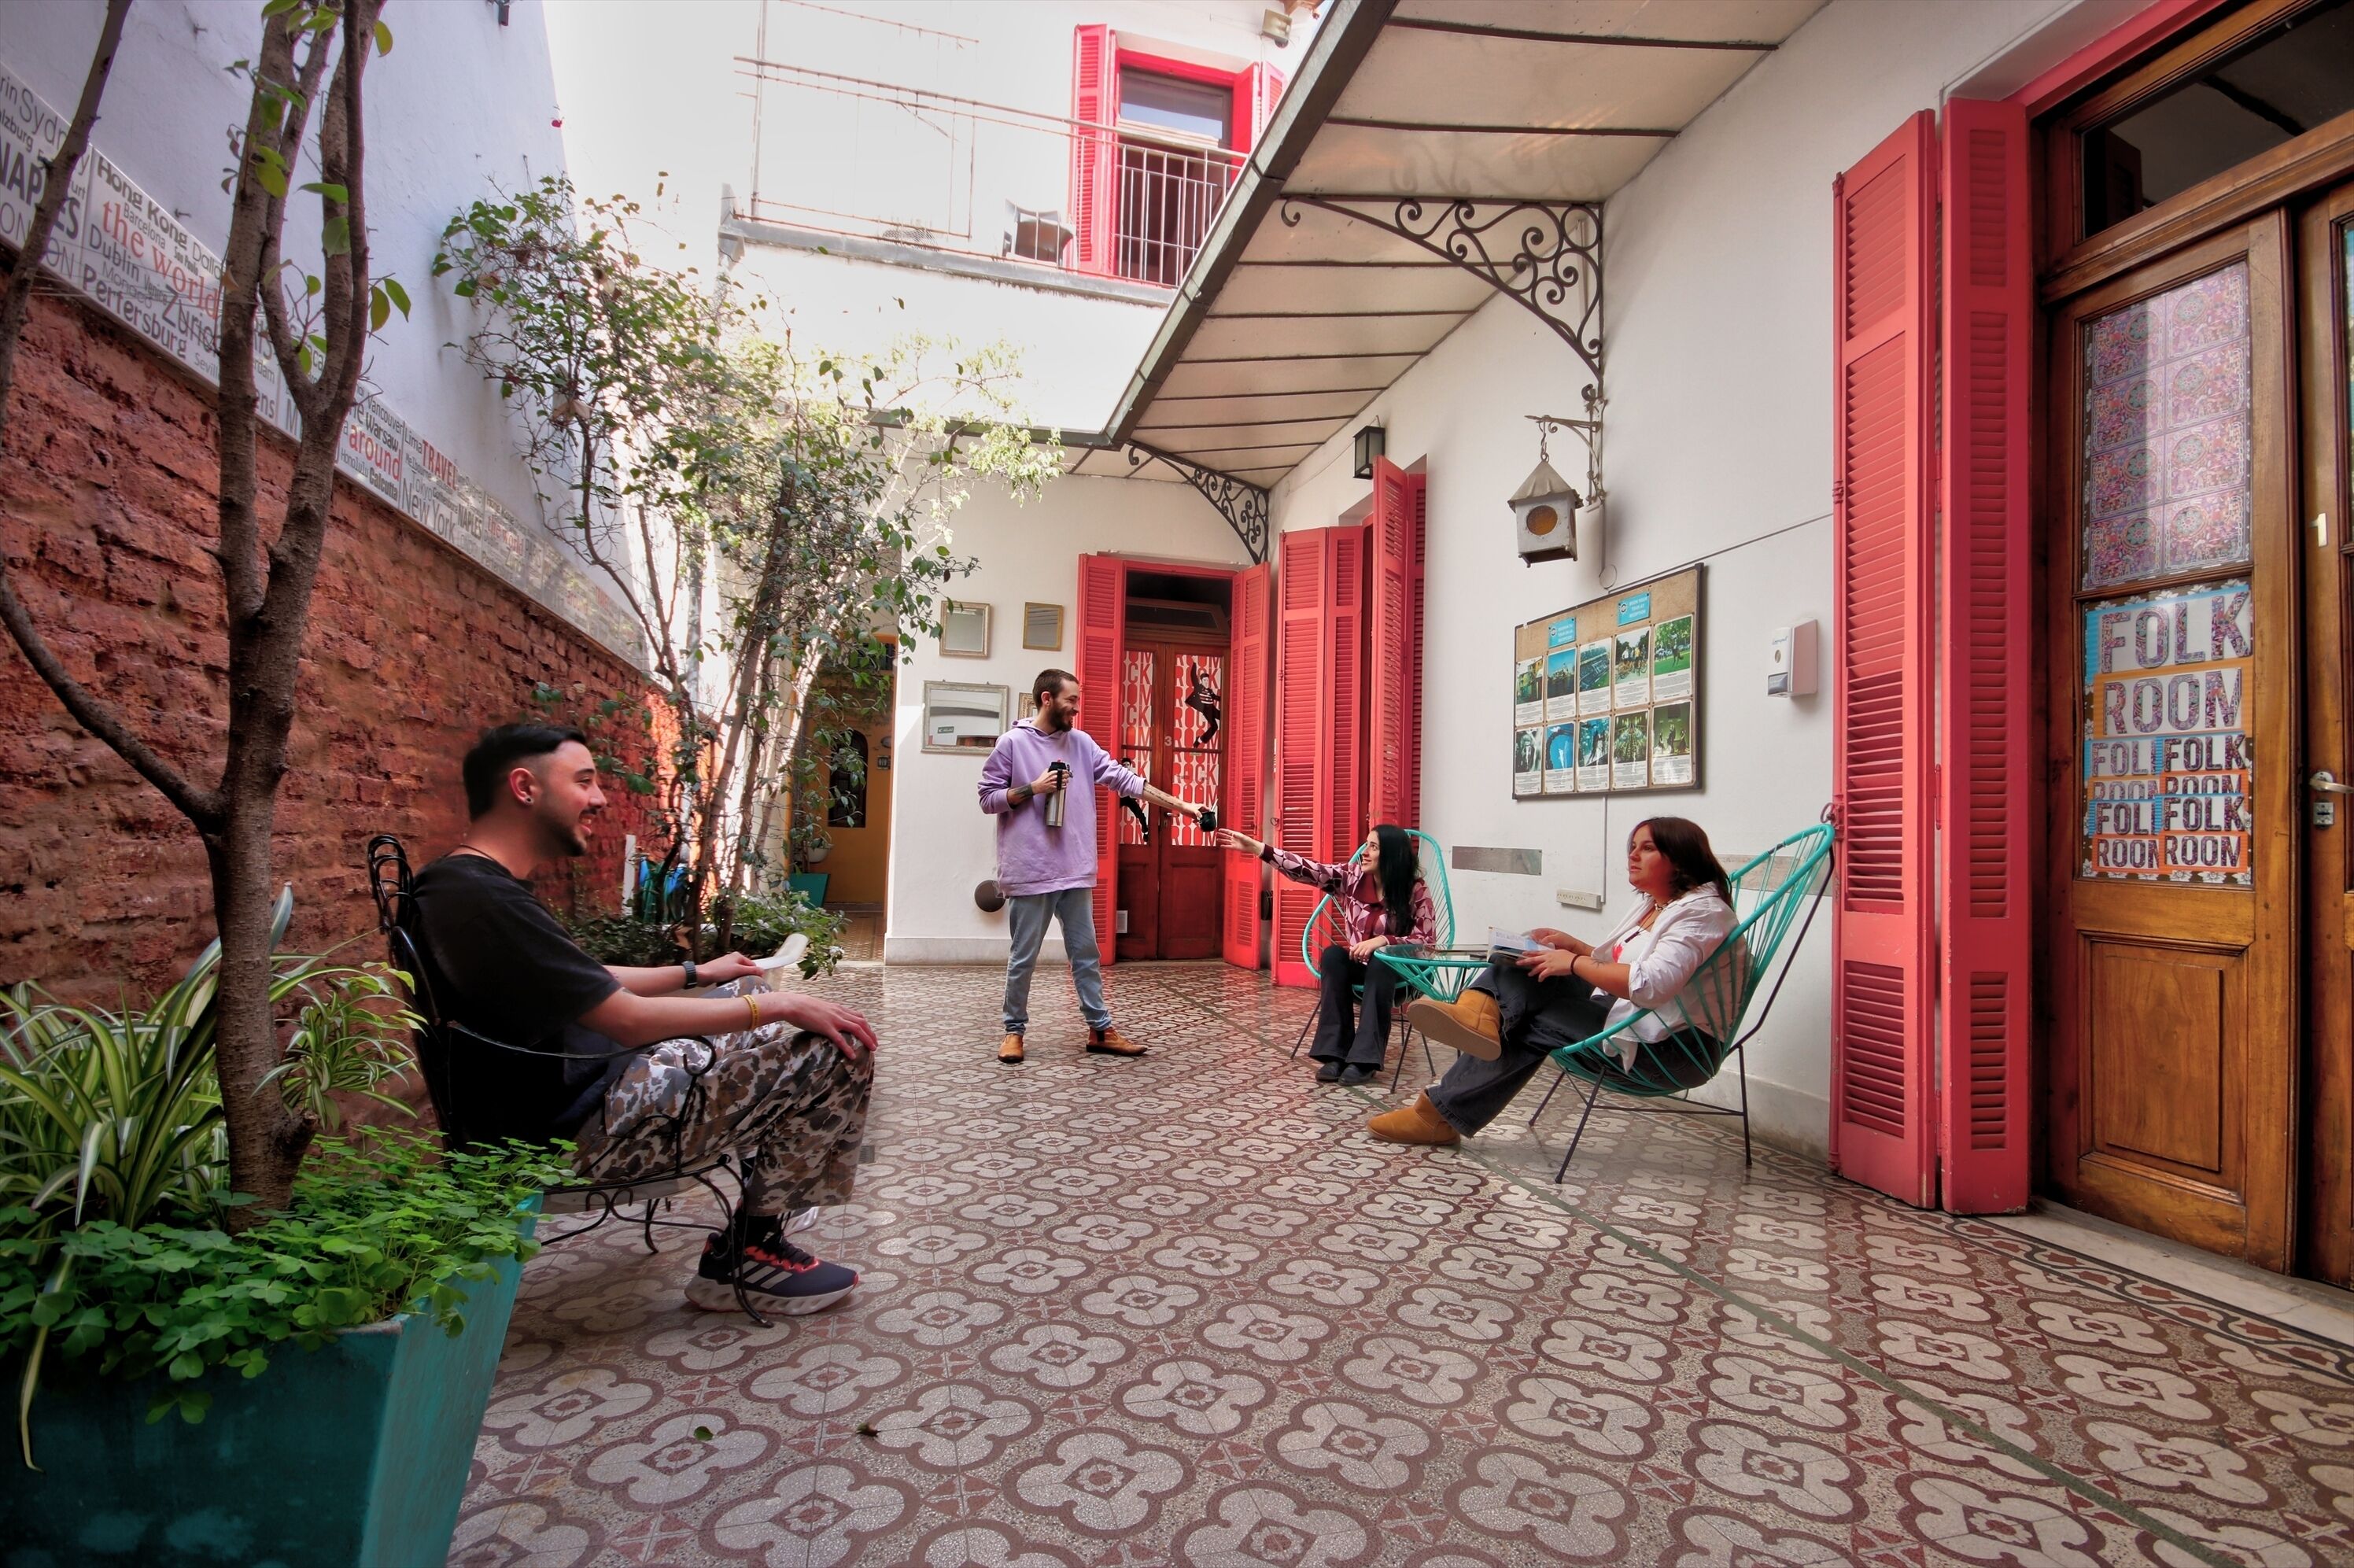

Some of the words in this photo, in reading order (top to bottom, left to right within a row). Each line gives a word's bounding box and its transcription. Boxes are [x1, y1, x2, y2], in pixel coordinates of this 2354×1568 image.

[0, 109, 33, 153] lzburg
[97, 156, 143, 212] Hong
[147, 200, 188, 250] Kong
[124, 202, 166, 249] Barcelona
[90, 223, 139, 282] Dublin
[103, 201, 144, 259] the
[152, 245, 220, 320] world
[102, 261, 153, 309] Monaco
[194, 352, 220, 378] Sevill
[365, 411, 399, 453] Warsaw
[367, 393, 403, 434] Vancouver
[341, 447, 369, 478] Honolulu
[349, 424, 402, 481] around
[404, 427, 422, 454] Lima
[422, 439, 457, 491] TRAVEL
[369, 467, 399, 502] Calcutta
[411, 470, 433, 503] Tokyo
[402, 478, 430, 526] New
[433, 500, 456, 544] York
[458, 504, 482, 540] NAPLES
[2100, 590, 2253, 674] FOLK
[2103, 666, 2243, 736] ROOM
[1164, 736, 1172, 747] 3
[2164, 733, 2246, 773] FOLK
[2164, 795, 2245, 832] FOLK
[2164, 835, 2241, 867] ROOM
